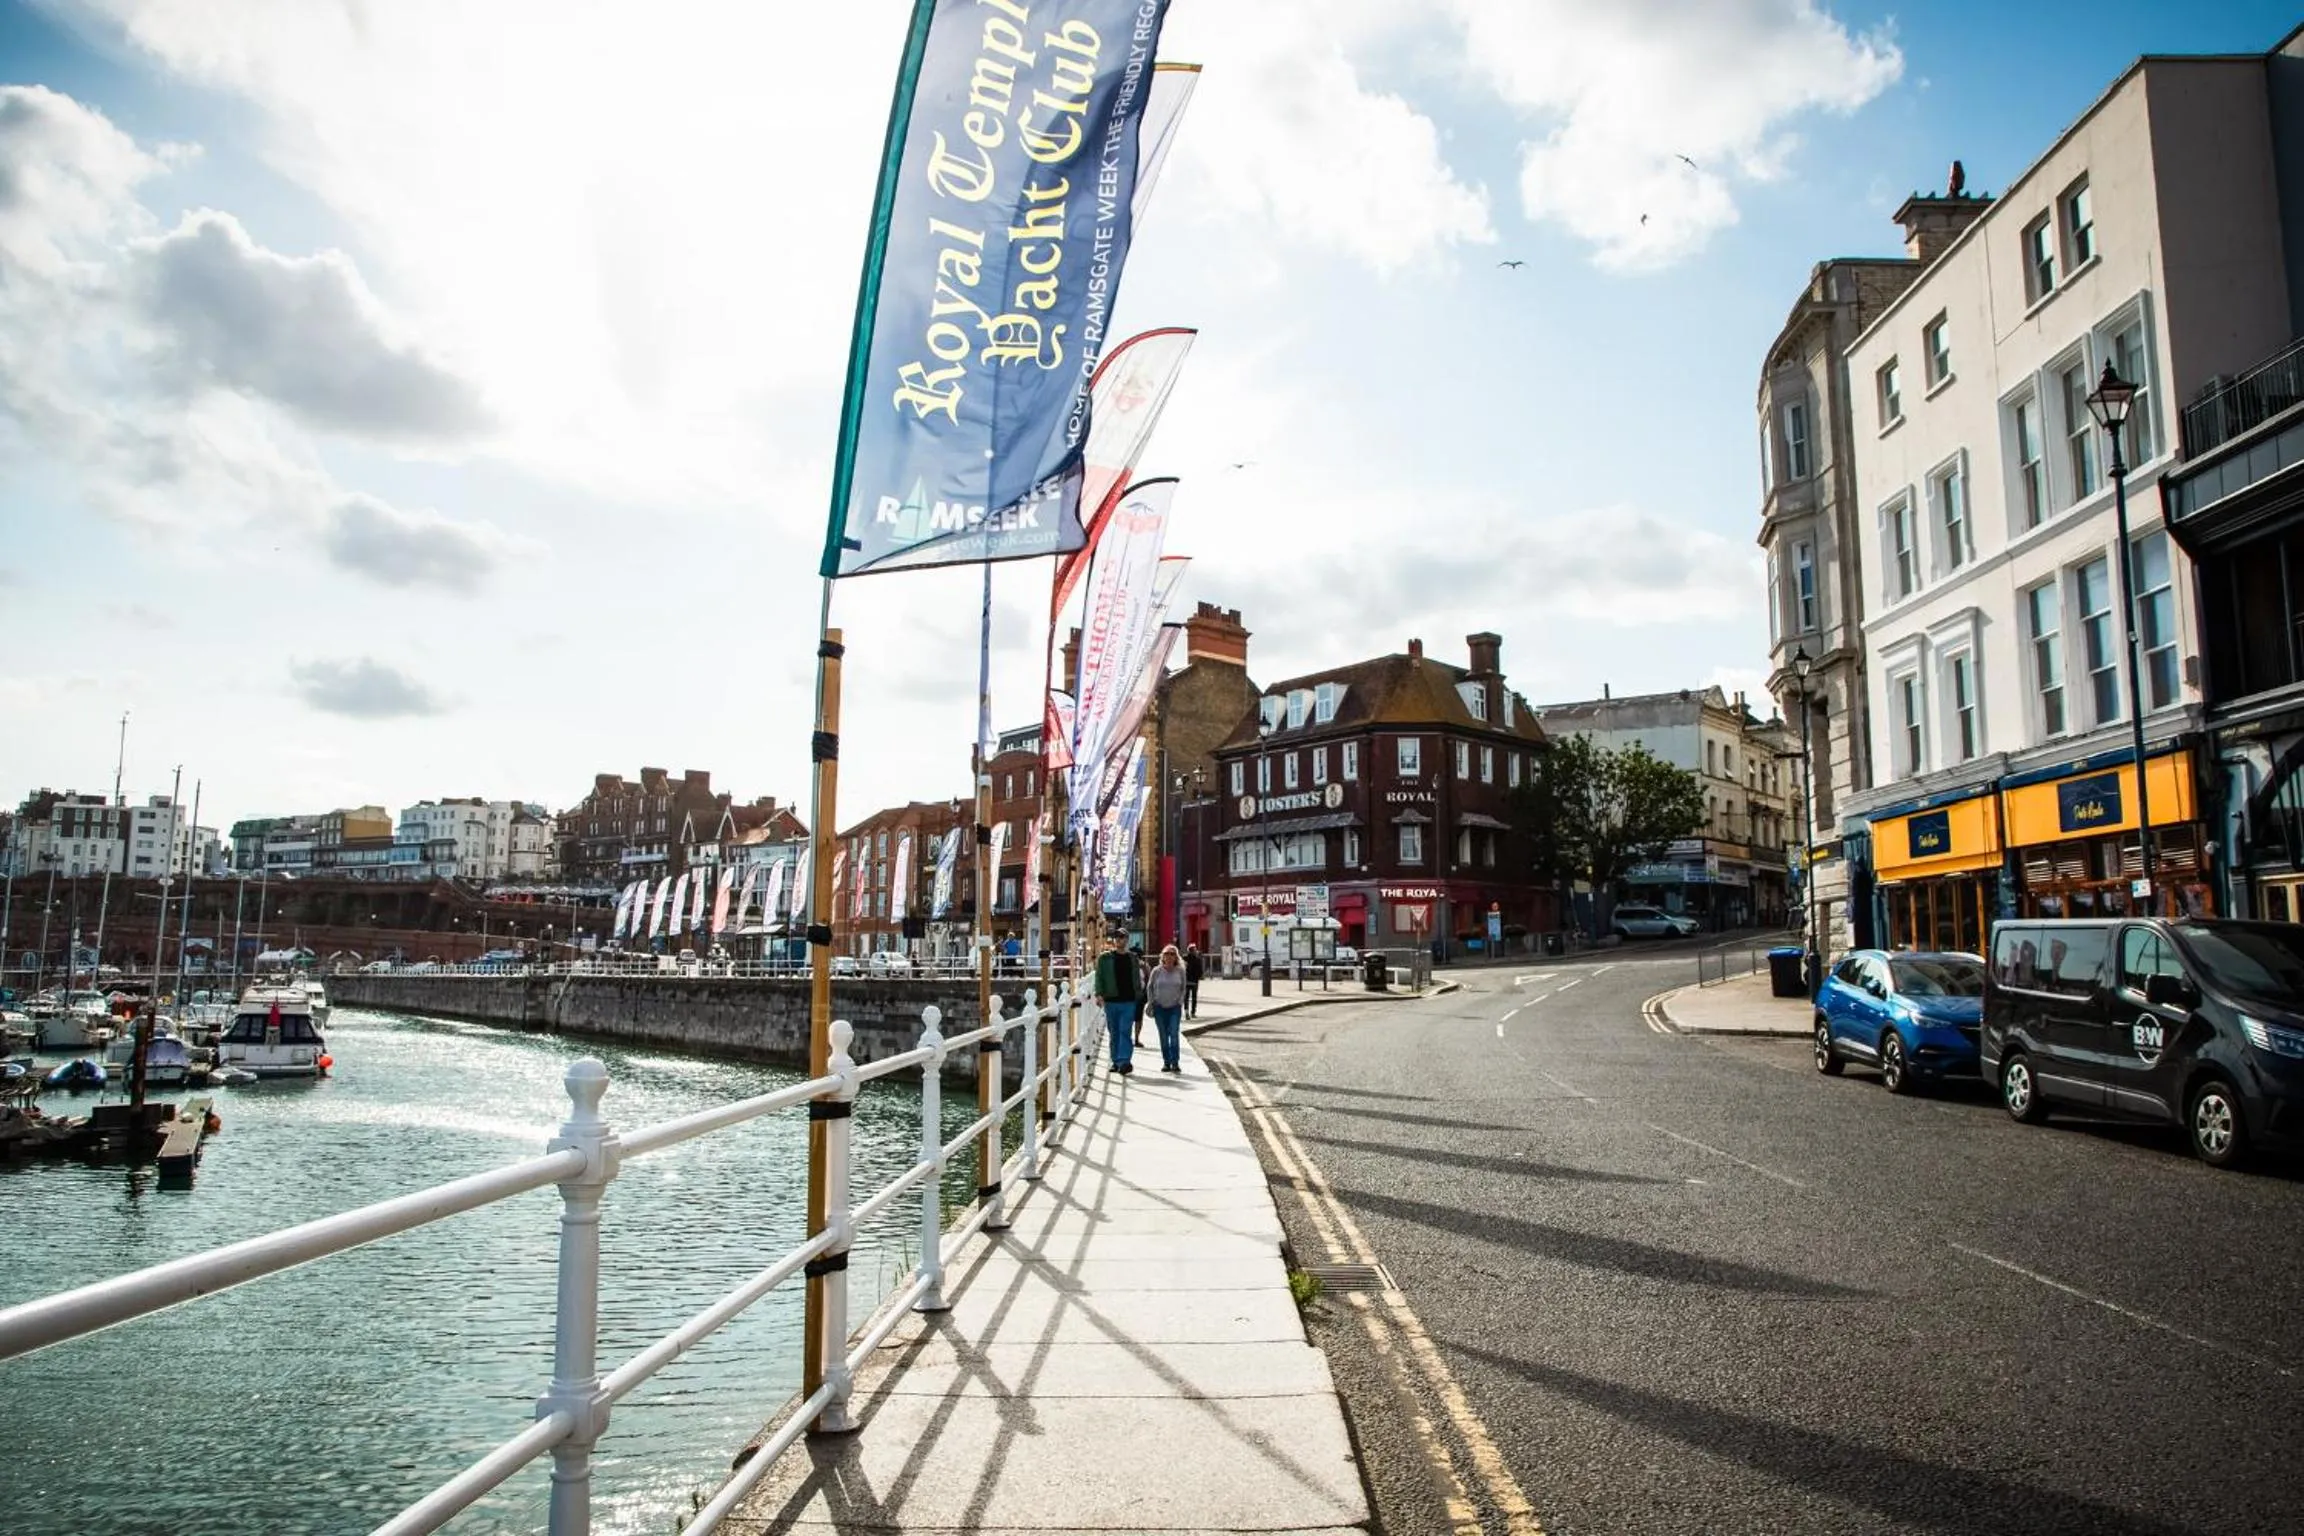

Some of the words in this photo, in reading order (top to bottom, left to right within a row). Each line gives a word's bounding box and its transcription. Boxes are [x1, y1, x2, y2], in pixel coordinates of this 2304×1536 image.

[926, 0, 1037, 203] Templ
[1019, 18, 1101, 164] Club
[1113, 44, 1147, 119] FRIENDLY
[1104, 116, 1124, 157] THE
[1096, 158, 1120, 222] WEEK
[981, 176, 1069, 370] Yacht
[1084, 227, 1115, 342] RAMSGATE
[893, 217, 989, 427] Royal
[1081, 347, 1098, 377] OF
[1067, 384, 1090, 449] HOME
[1386, 791, 1435, 802] ROYAL
[1267, 891, 1296, 905] ROYAL
[1380, 888, 1403, 898] THE
[1406, 887, 1445, 898] ROYA
